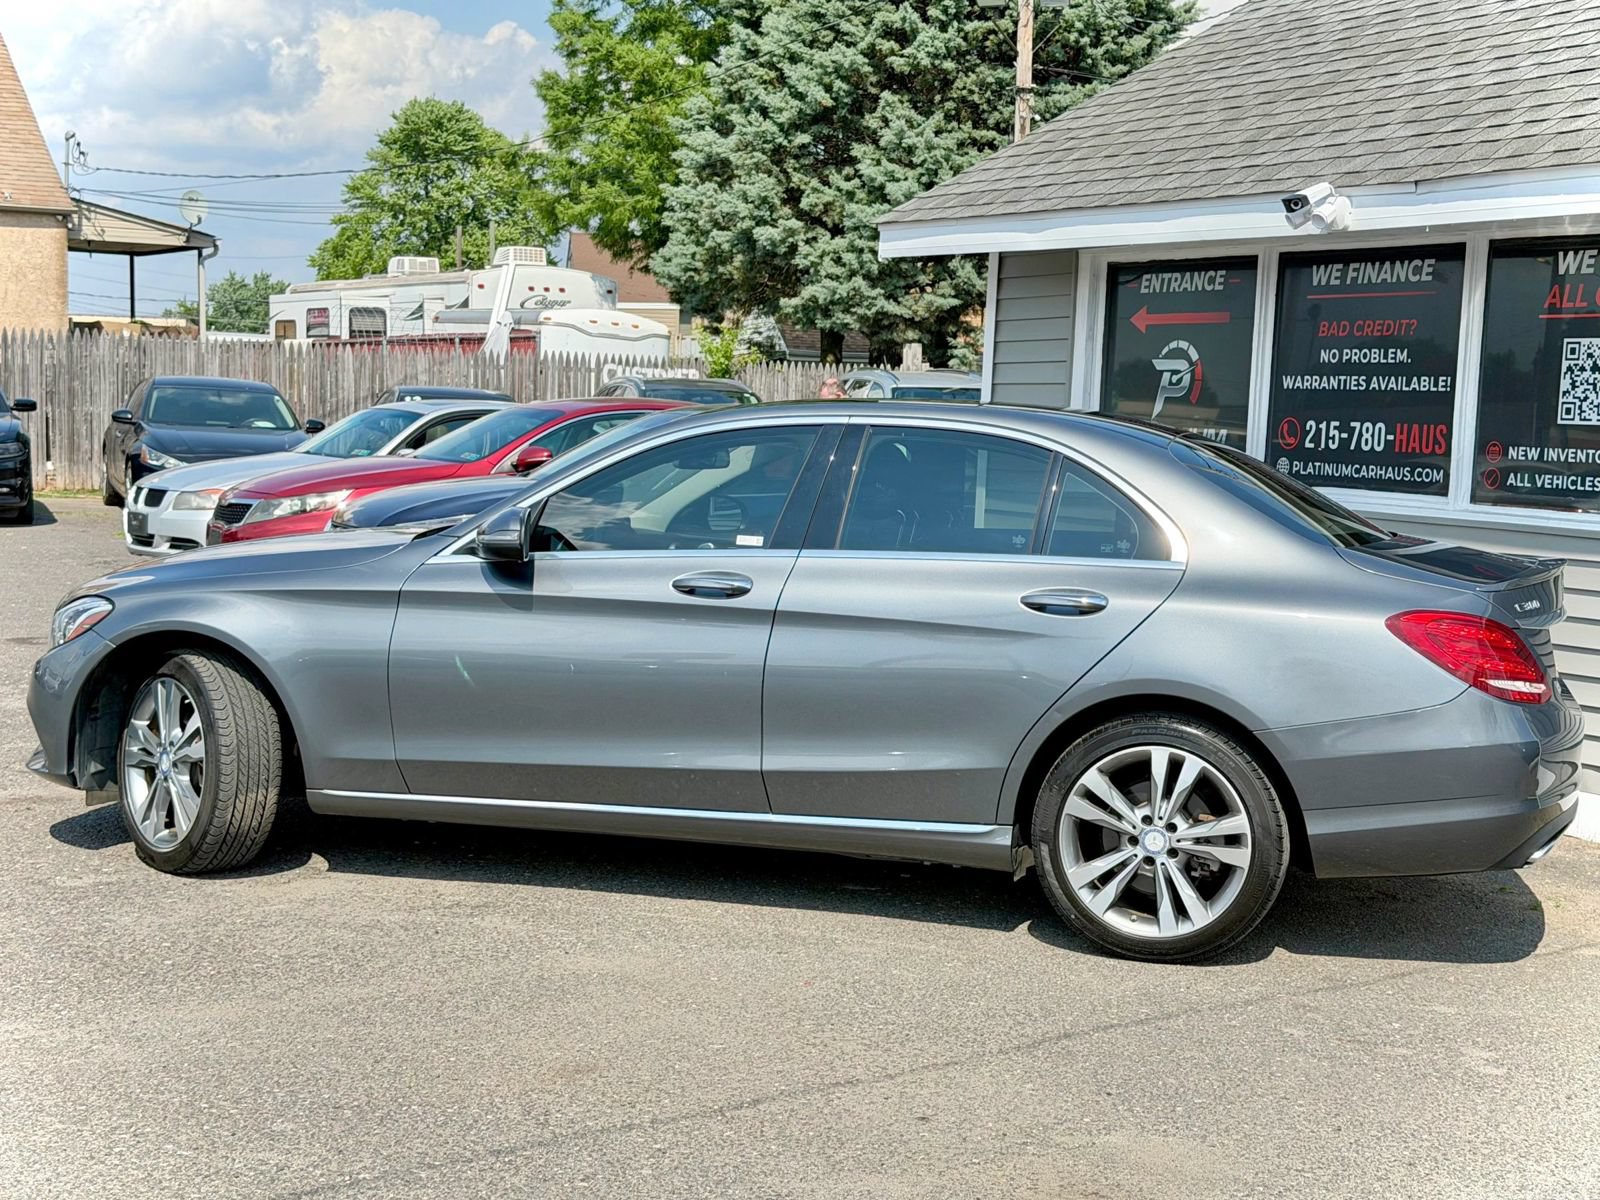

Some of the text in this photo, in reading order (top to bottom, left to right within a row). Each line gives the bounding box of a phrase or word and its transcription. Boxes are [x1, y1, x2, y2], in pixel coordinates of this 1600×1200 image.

[1312, 258, 1436, 286] WE FINANCE
[1558, 249, 1599, 275] WE
[1140, 270, 1226, 293] ENTRANCE
[1543, 283, 1589, 308] ALL
[1318, 319, 1418, 337] BAD CREDIT?
[1320, 348, 1412, 364] NO PROBLEM.
[1282, 375, 1452, 392] WARRANTIES AVAILABLE!
[1304, 420, 1447, 454] 215-780-HAUS
[1508, 446, 1541, 461] NEW
[1292, 461, 1444, 483] PLATINUMCARHAUS.COM
[1506, 472, 1600, 491] ALL VEHICLES
